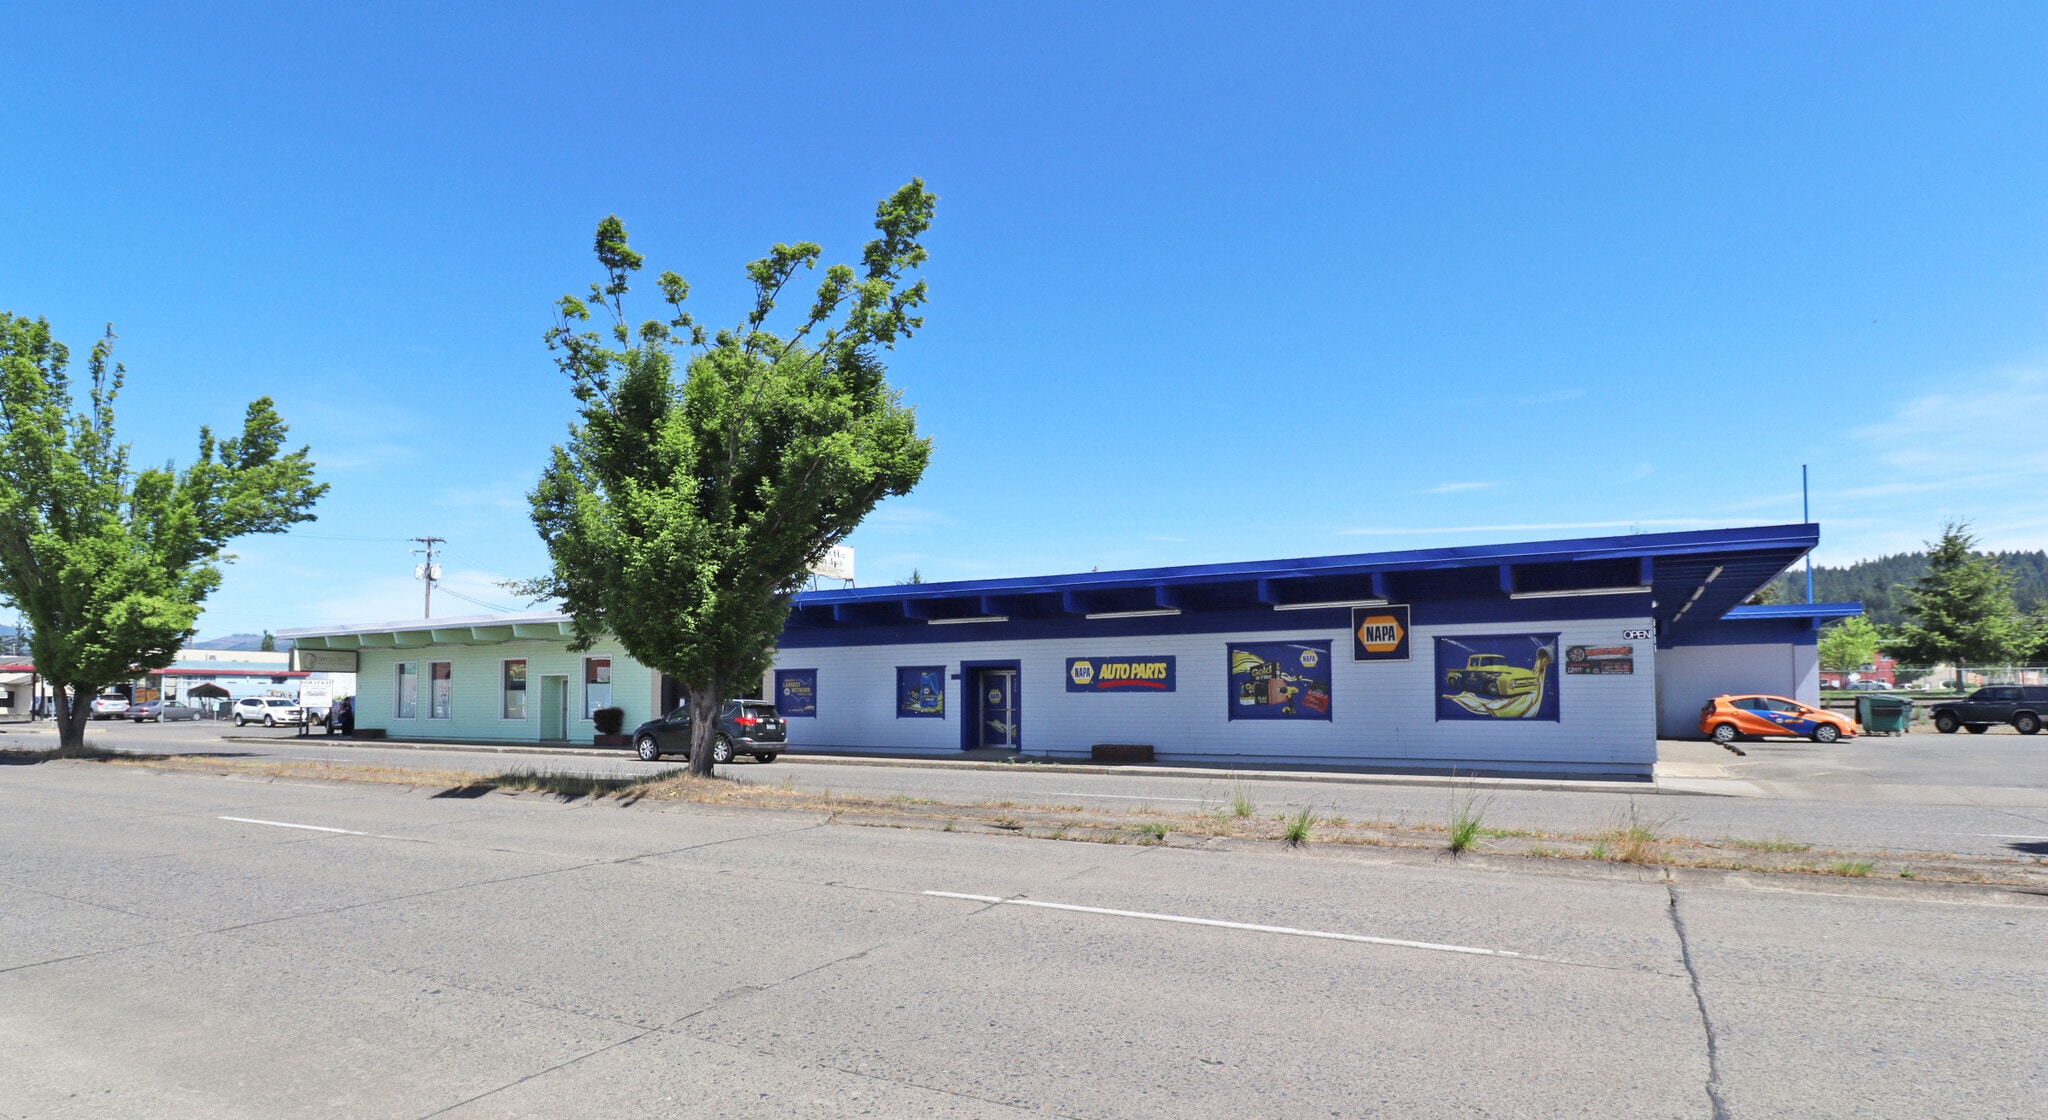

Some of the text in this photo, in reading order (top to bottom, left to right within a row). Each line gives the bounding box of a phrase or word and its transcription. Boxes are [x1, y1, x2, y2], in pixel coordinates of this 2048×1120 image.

[1366, 625, 1396, 642] NAPA
[1623, 630, 1651, 640] OPEN
[1302, 654, 1316, 663] NAPA
[1074, 662, 1167, 679] NAPA AUTO PARTS
[1251, 665, 1273, 677] Gold
